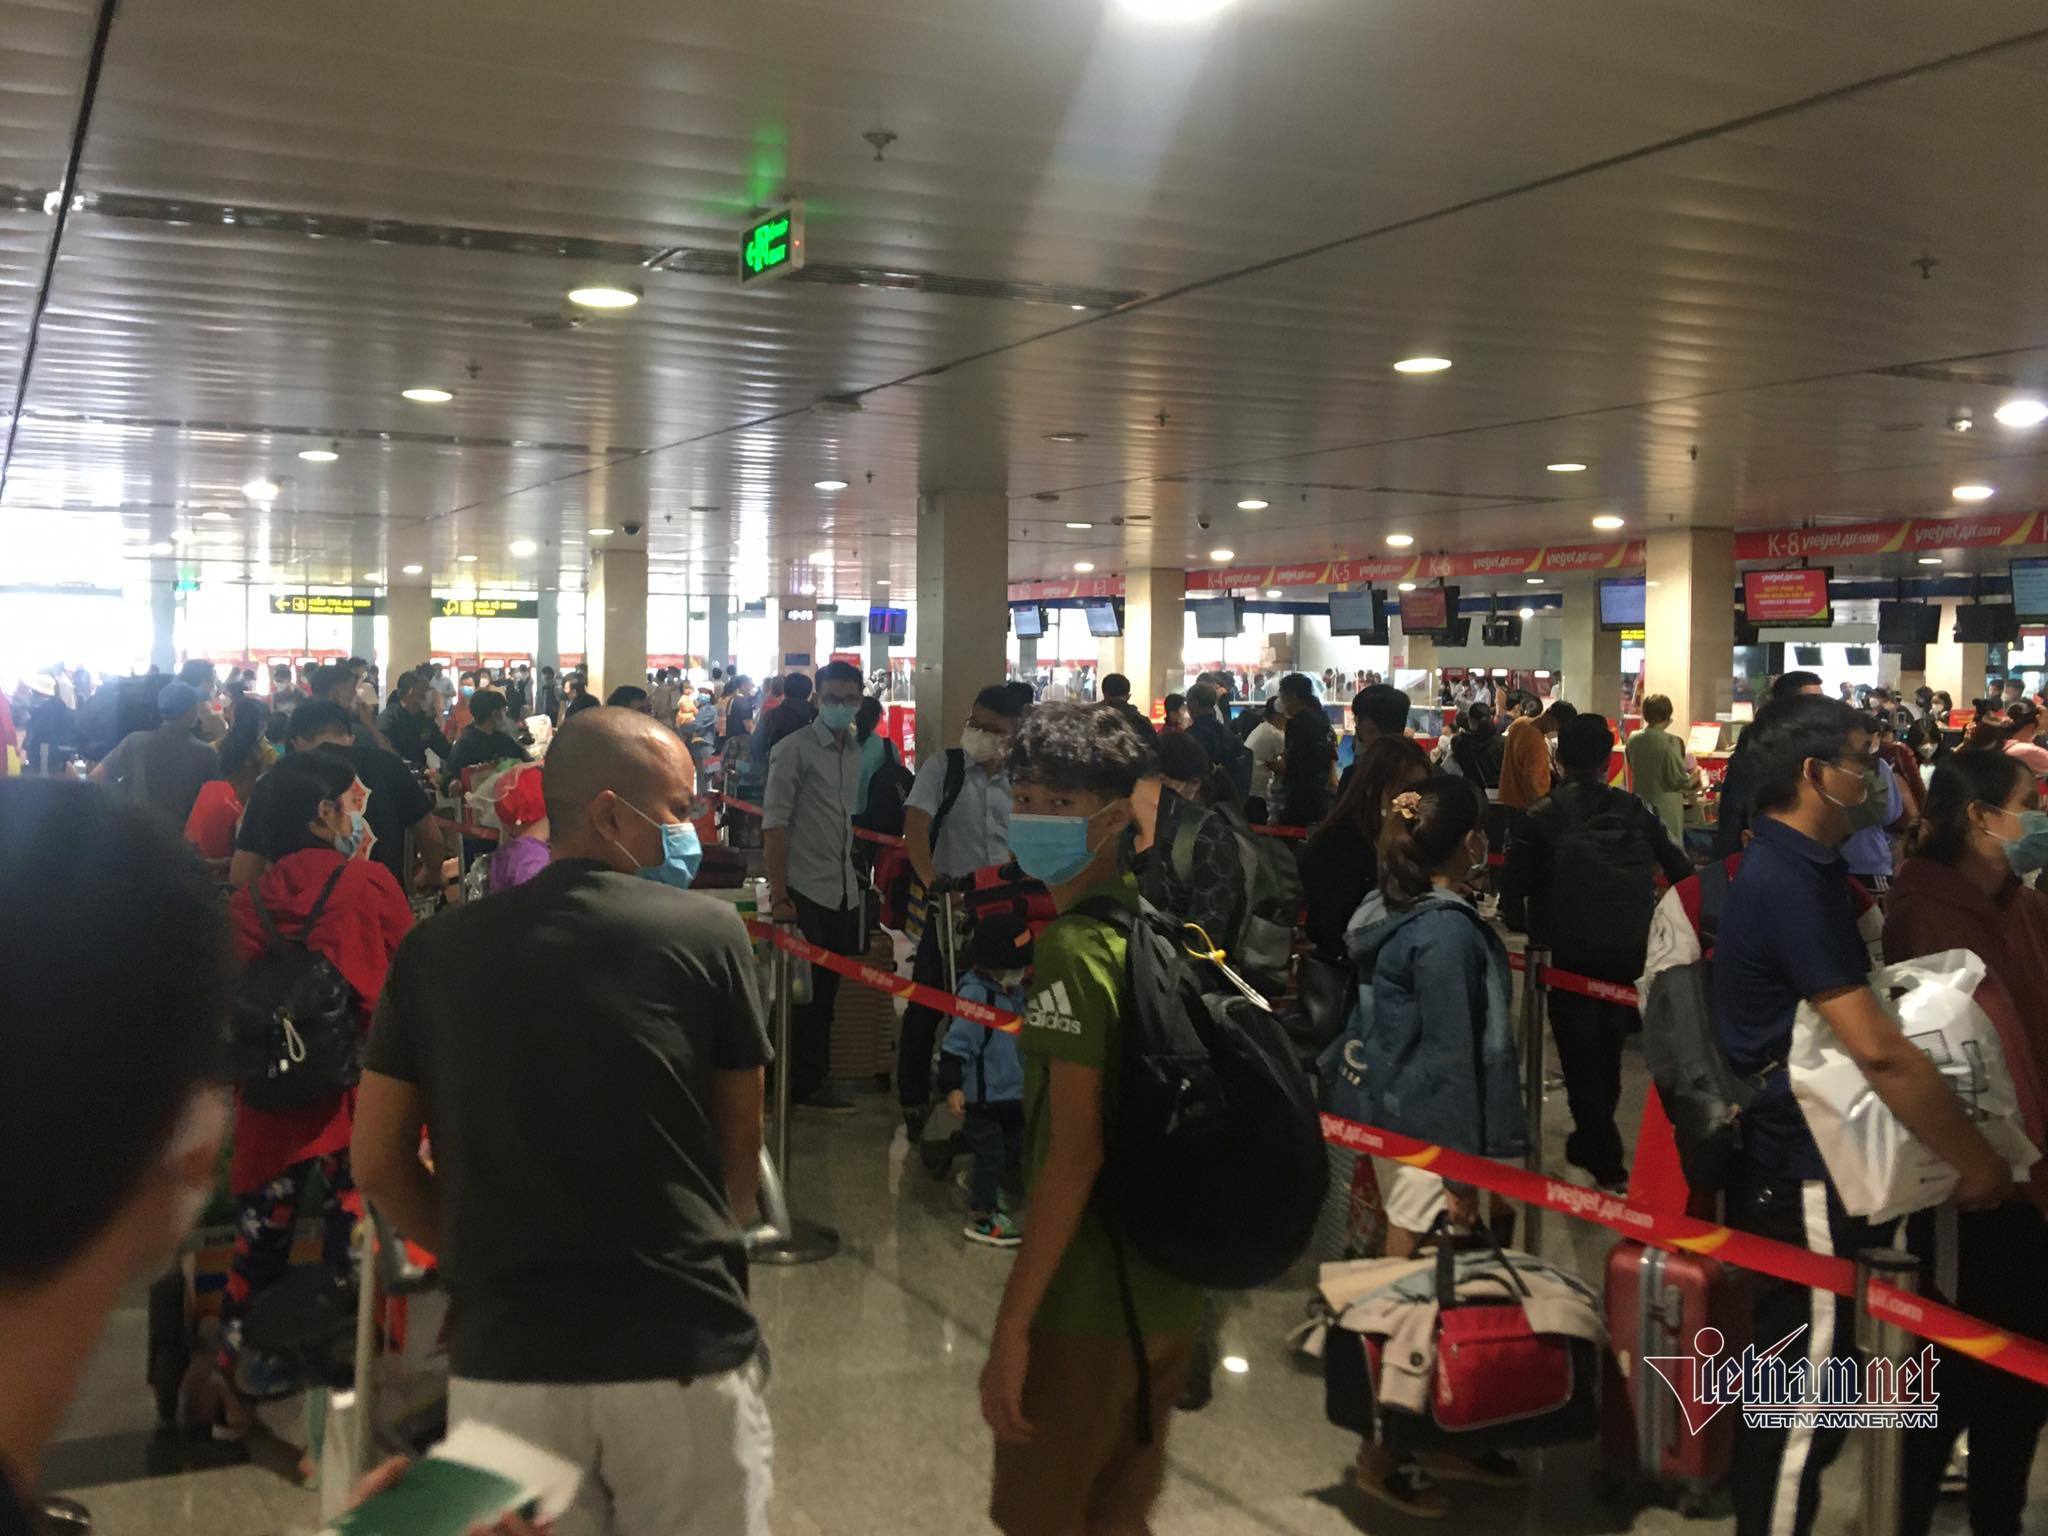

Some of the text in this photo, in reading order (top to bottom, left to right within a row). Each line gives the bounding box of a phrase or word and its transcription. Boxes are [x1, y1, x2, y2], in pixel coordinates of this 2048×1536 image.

[1768, 532, 1799, 556] K-8
[1429, 559, 1450, 576] K-6
[1024, 1010, 1082, 1035] adidas
